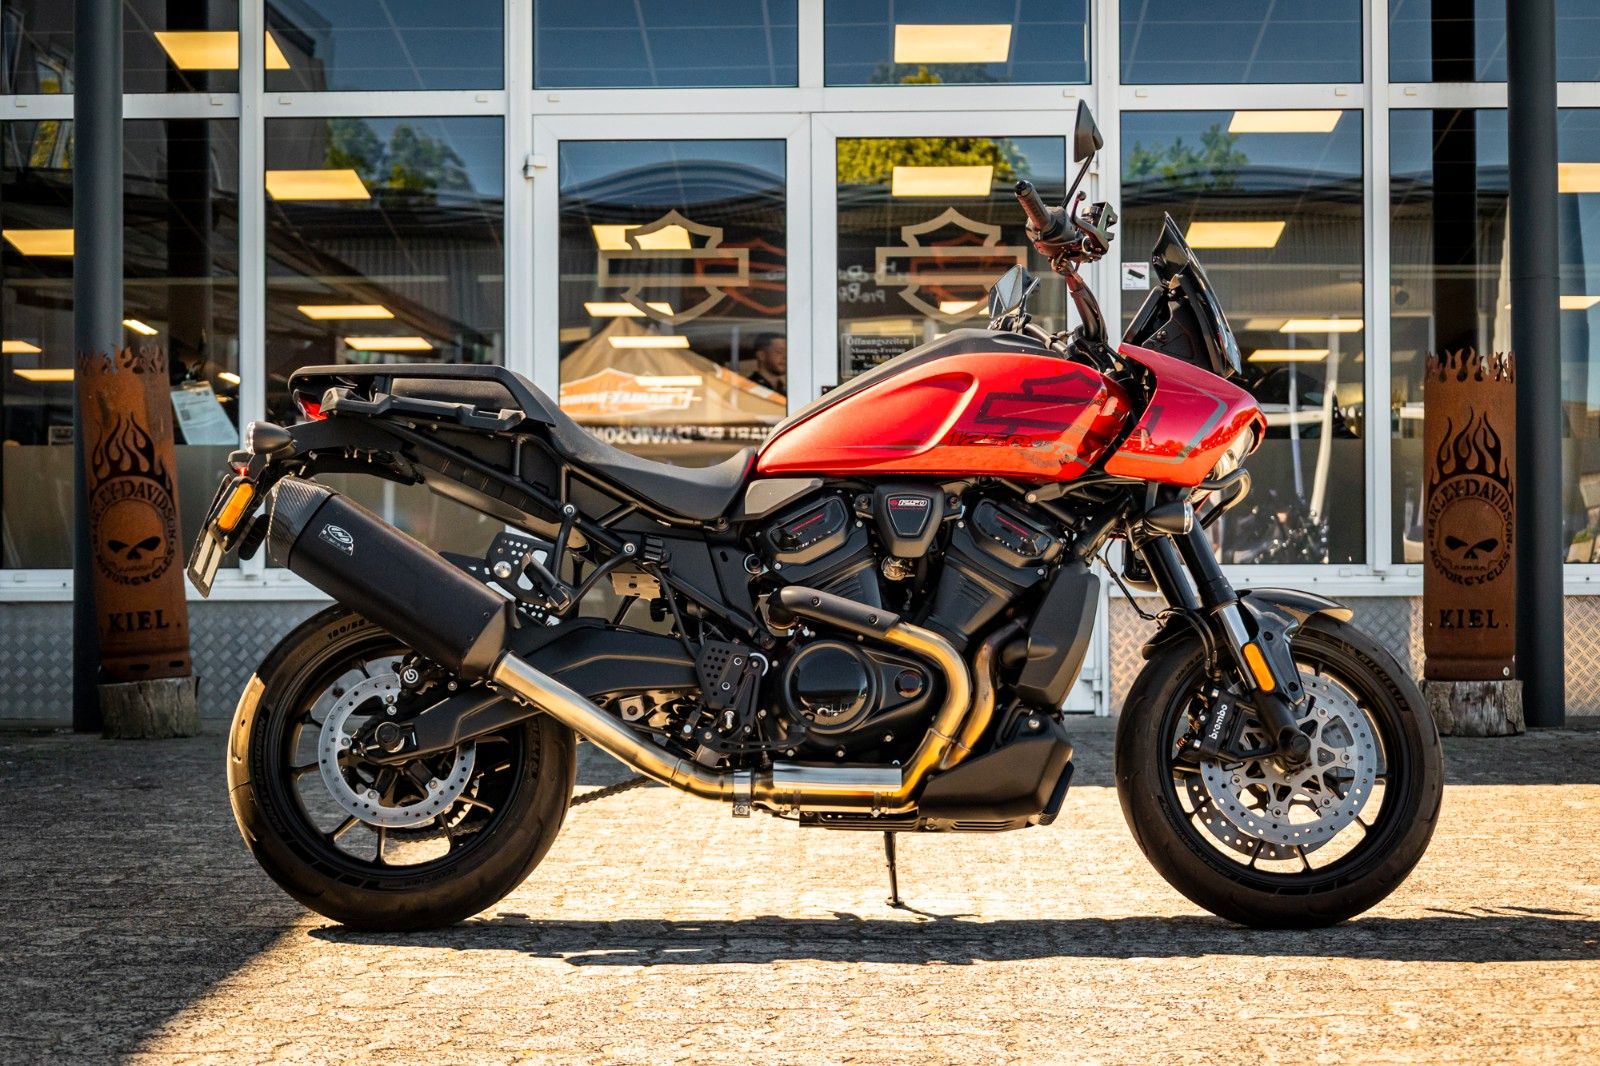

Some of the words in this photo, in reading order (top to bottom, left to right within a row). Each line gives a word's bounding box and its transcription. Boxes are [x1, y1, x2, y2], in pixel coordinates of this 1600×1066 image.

[108, 609, 170, 633] KIEL
[1438, 608, 1500, 629] KIEL
[1208, 704, 1228, 740] brembo
